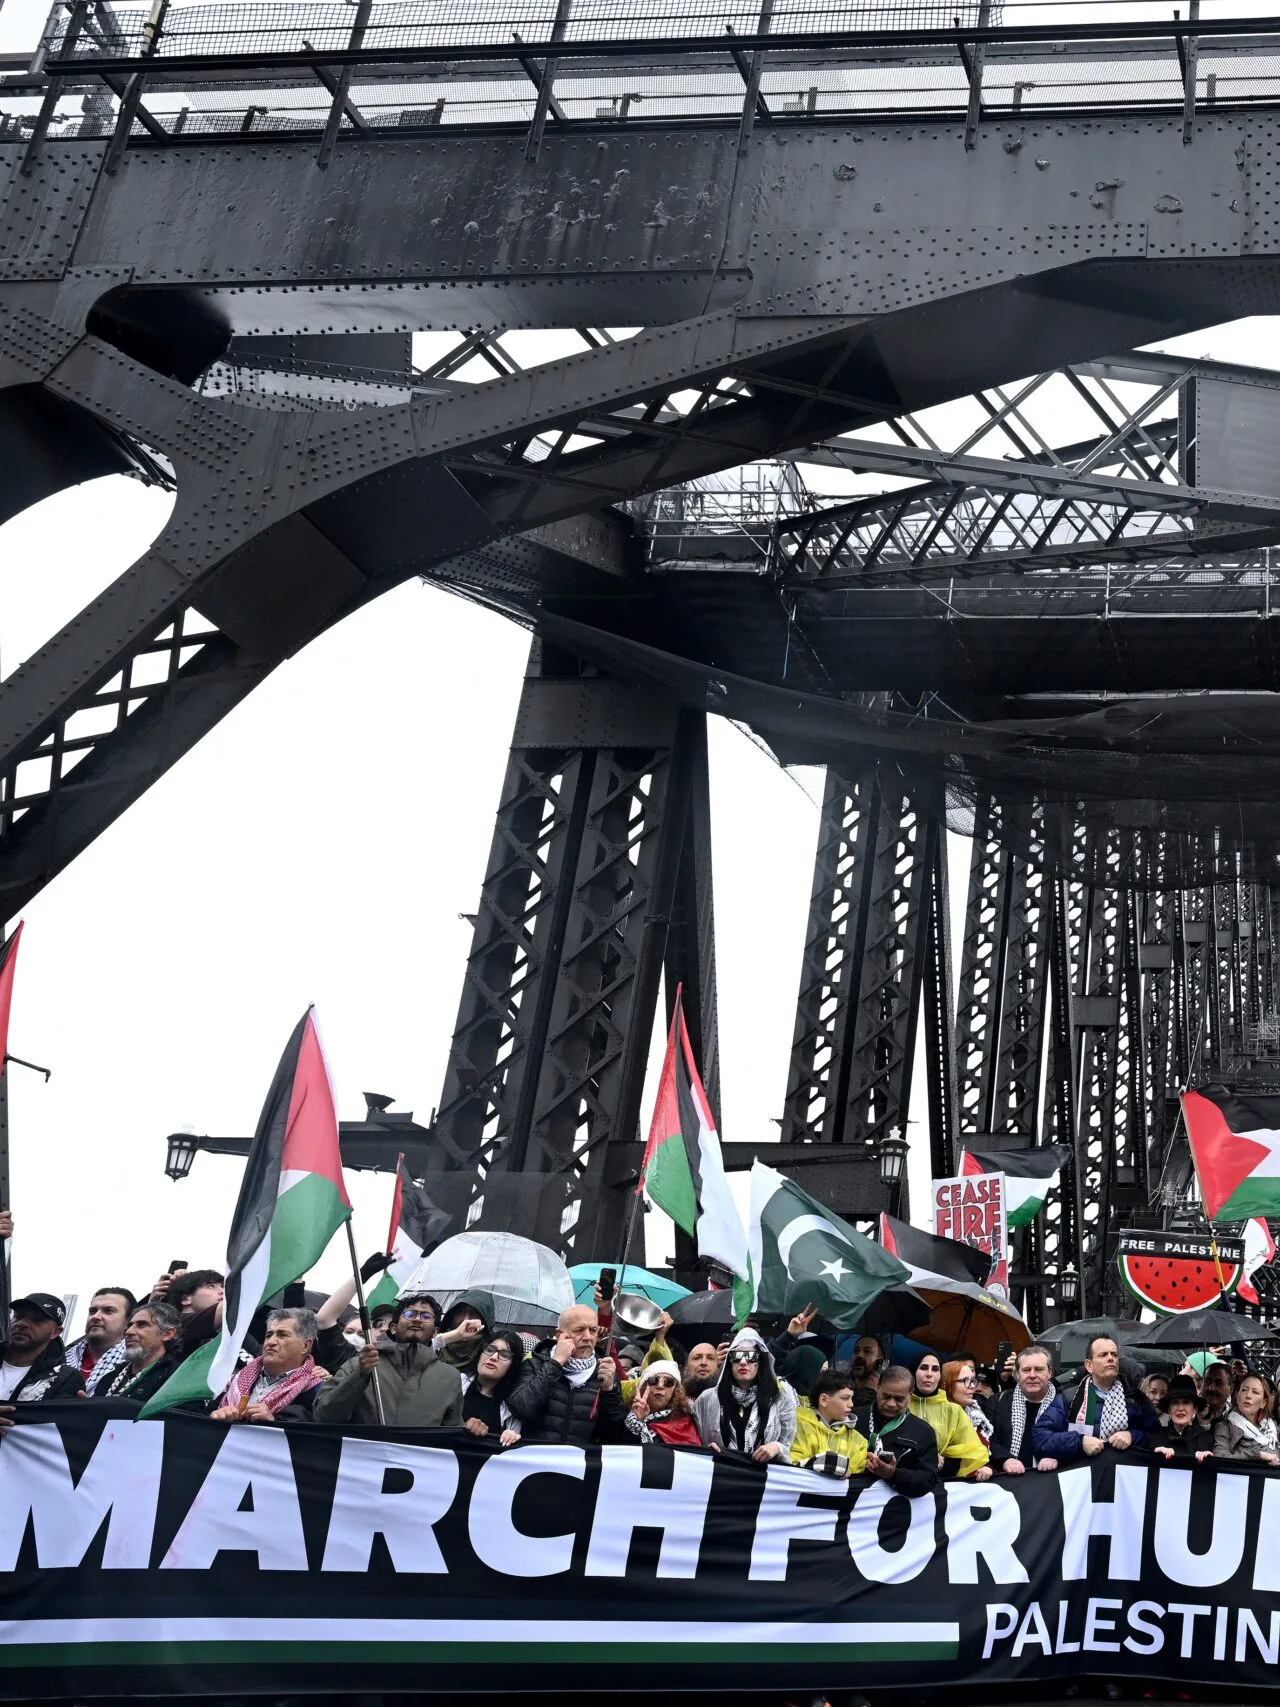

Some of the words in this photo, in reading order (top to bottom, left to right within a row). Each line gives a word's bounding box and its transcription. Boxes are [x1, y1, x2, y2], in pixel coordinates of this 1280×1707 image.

[935, 1178, 1000, 1208] CEASE
[936, 1201, 1001, 1240] FIRE
[1120, 1239, 1155, 1251] FREE
[1164, 1242, 1241, 1258] PALESTINE
[0, 1418, 713, 1581] MARCH
[747, 1462, 1029, 1586] FOR
